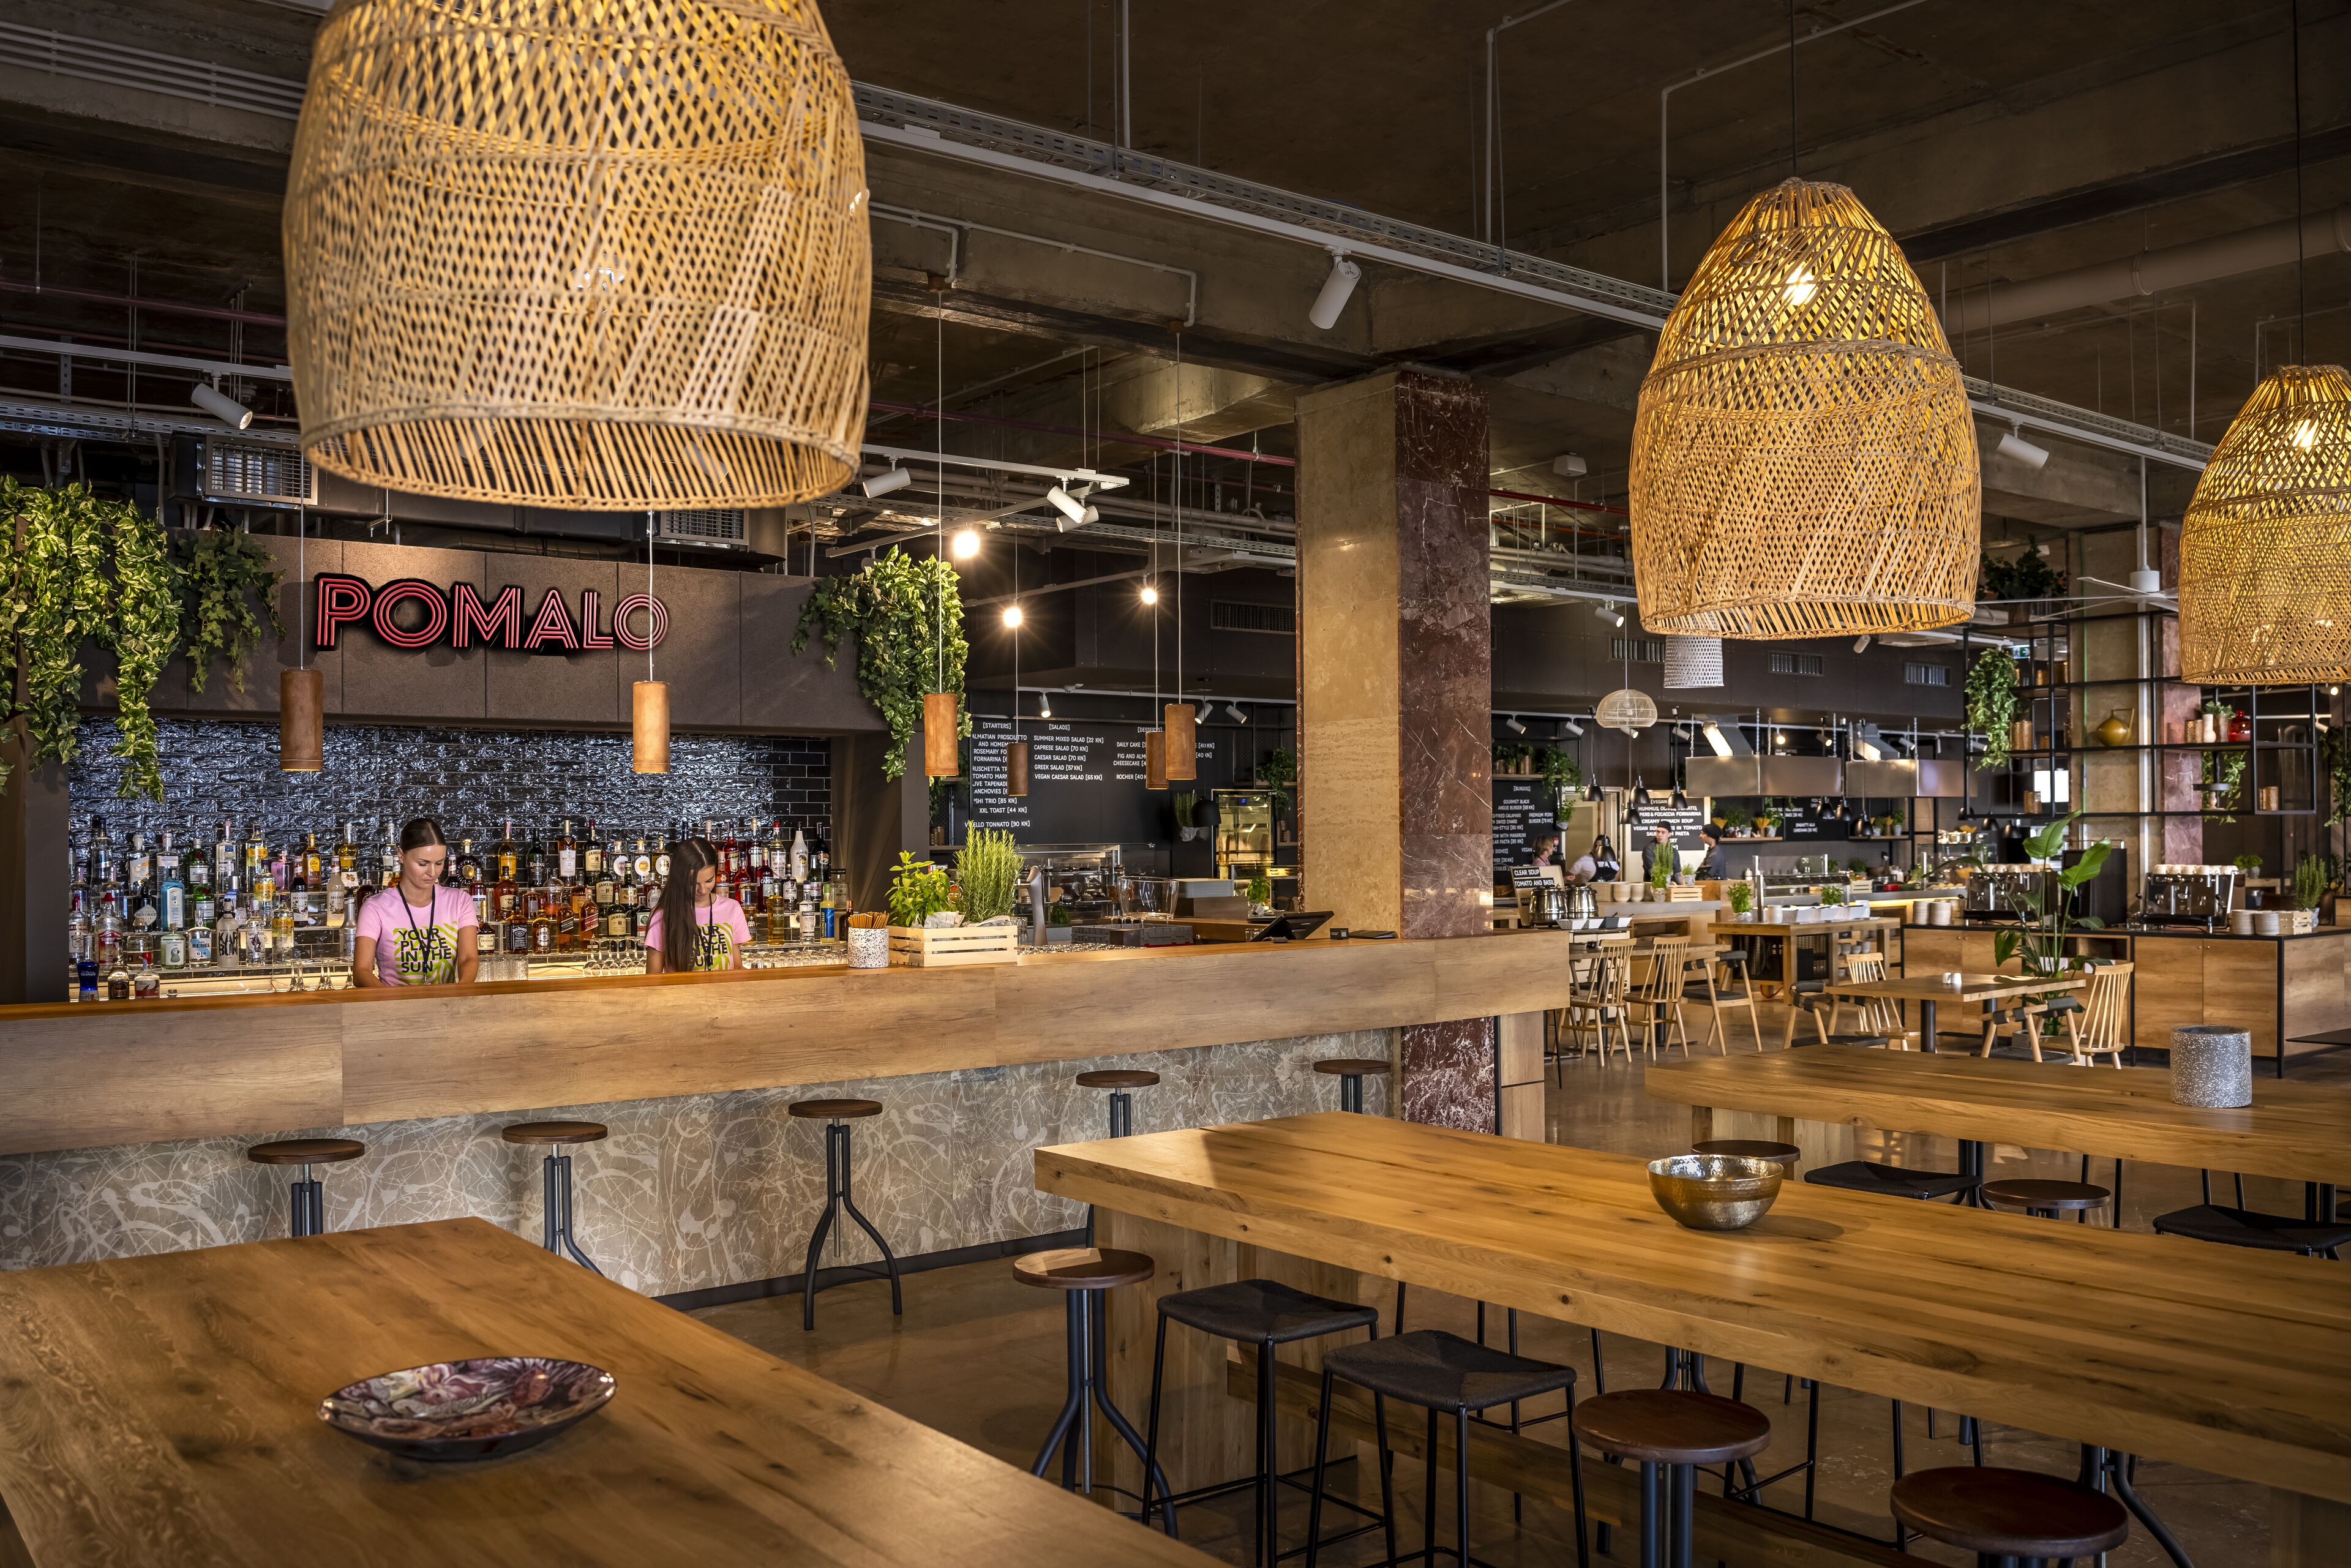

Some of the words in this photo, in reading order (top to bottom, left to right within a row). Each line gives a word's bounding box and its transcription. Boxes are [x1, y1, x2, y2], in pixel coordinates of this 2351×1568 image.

[316, 577, 669, 650] POMALO
[397, 928, 440, 940] YOUR
[701, 926, 720, 936] UR
[400, 937, 448, 951] PLACE
[711, 943, 728, 955] HE
[401, 951, 418, 962] IN
[429, 948, 452, 960] HE
[401, 961, 433, 973] SUN
